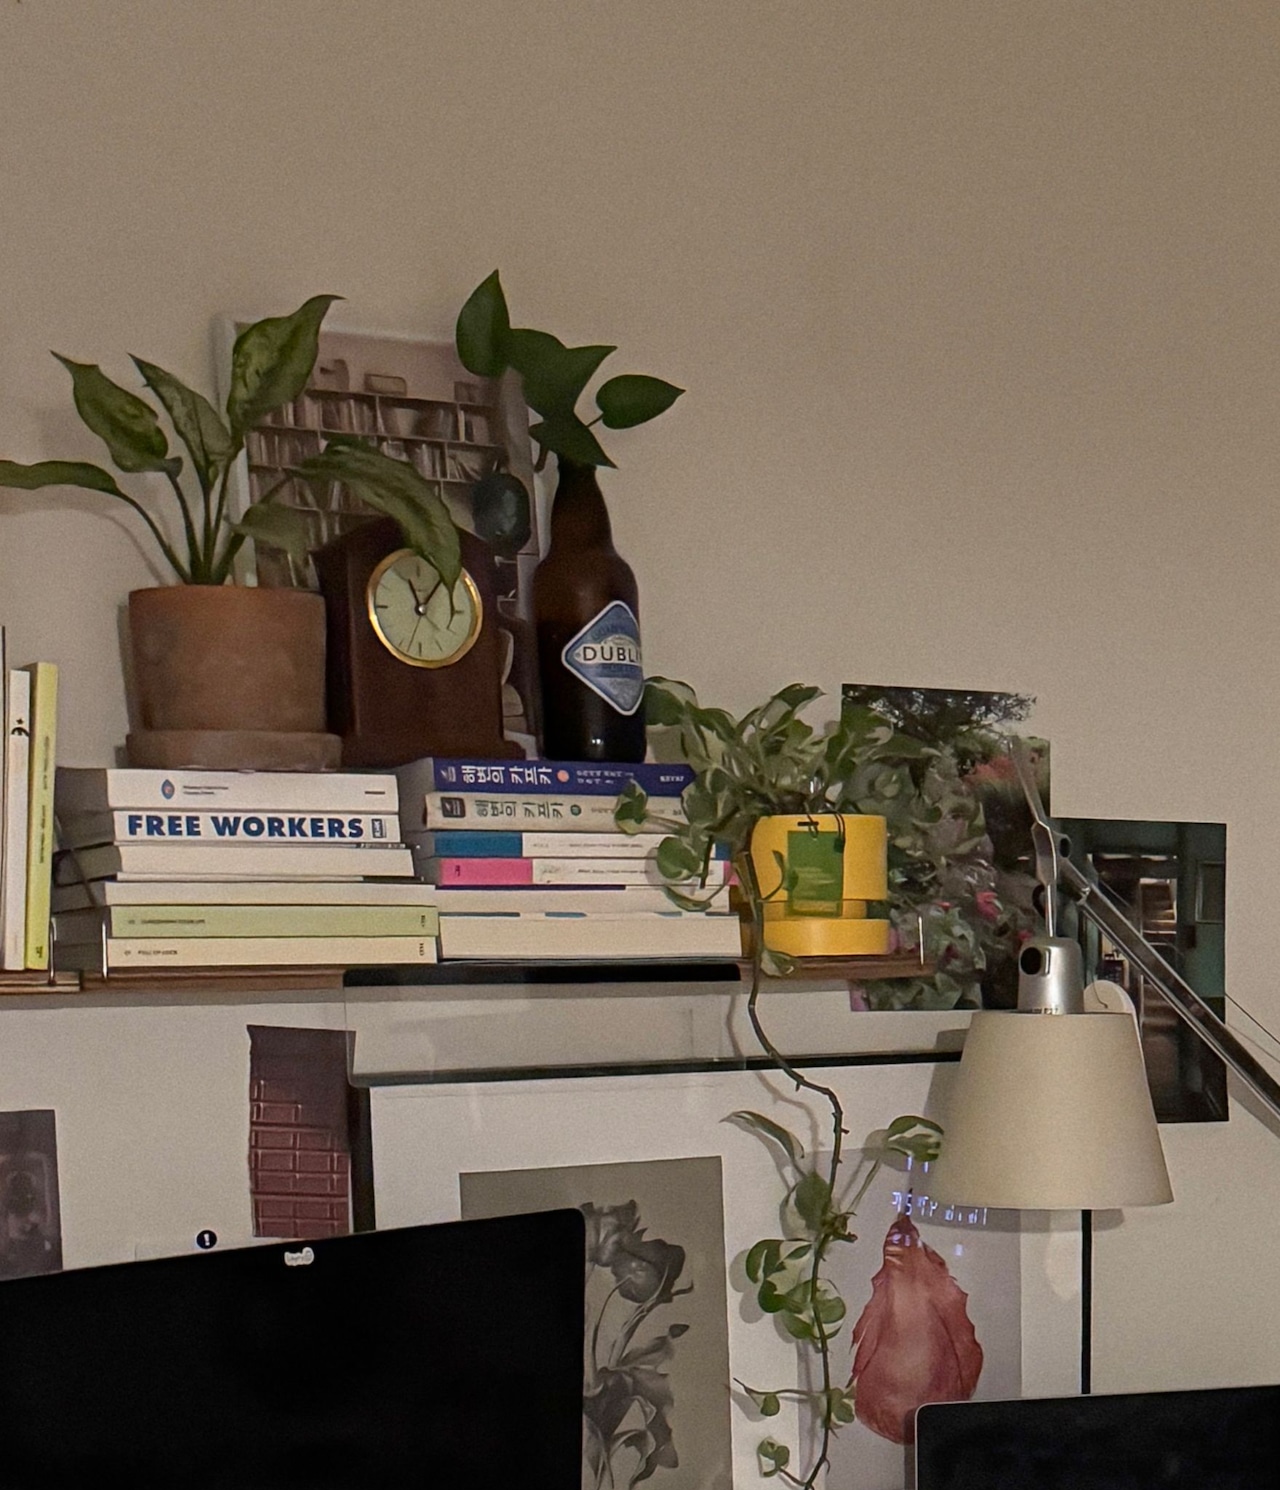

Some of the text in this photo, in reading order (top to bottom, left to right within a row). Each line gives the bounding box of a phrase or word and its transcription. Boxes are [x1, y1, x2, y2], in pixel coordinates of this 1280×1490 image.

[582, 646, 641, 663] DUBLI
[461, 765, 553, 785] 해변의 카프카
[475, 799, 564, 818] 해변의 카프카
[128, 815, 364, 838] FREE WORKERS
